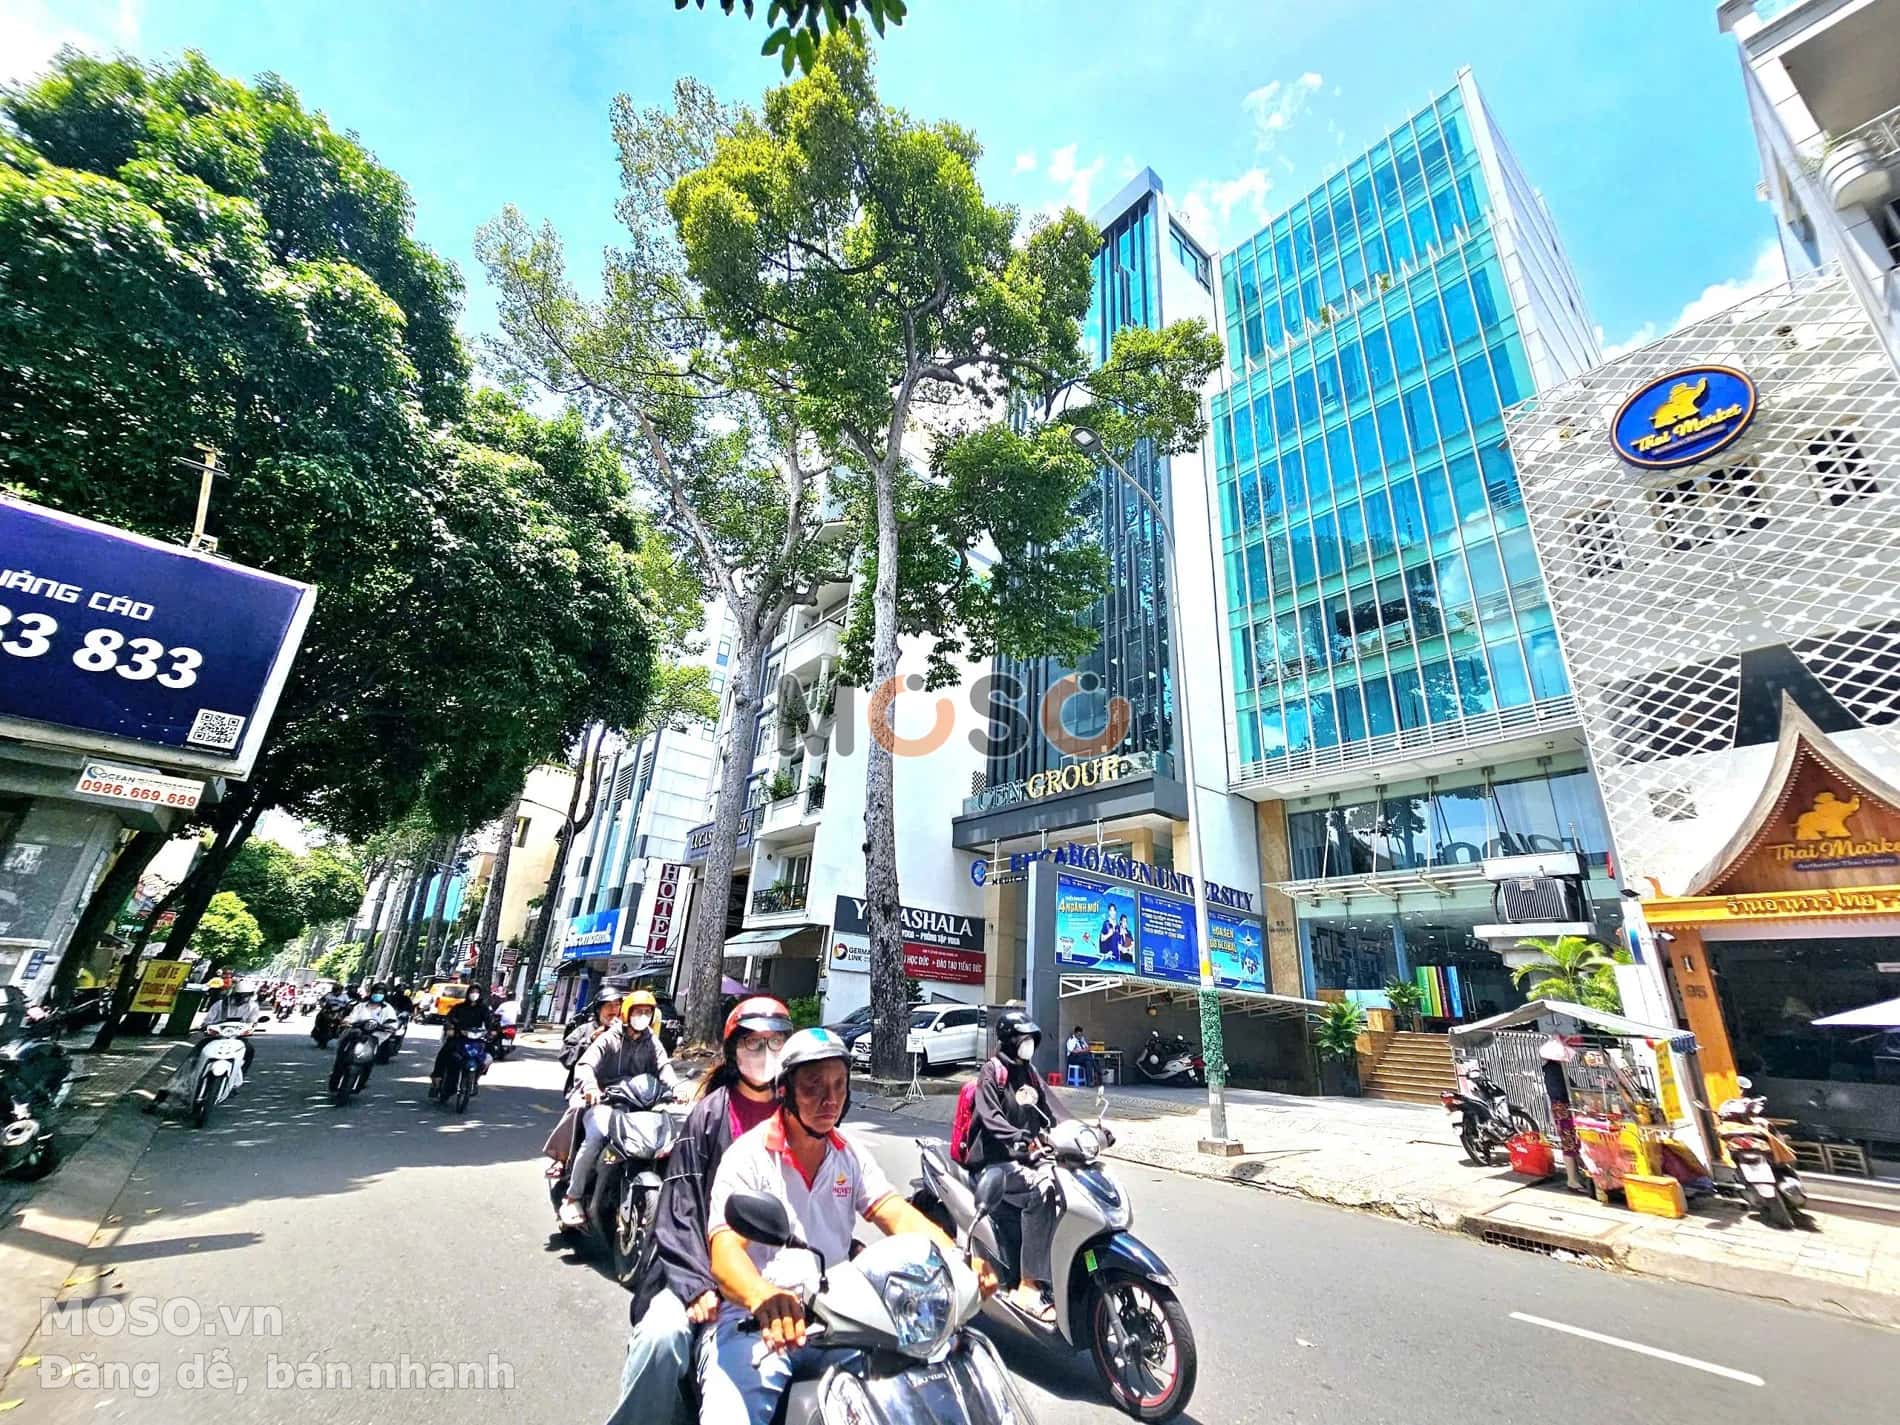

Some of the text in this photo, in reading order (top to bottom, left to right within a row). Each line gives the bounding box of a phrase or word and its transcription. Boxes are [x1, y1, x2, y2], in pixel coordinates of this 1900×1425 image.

[87, 592, 155, 621] CÁO
[72, 628, 203, 690] 833
[81, 779, 197, 807] 0986.669.689
[100, 772, 135, 783] OCEAN
[1026, 754, 1121, 800] GROUP
[1765, 843, 1819, 861] Thai
[1153, 865, 1254, 911] UNIVRSITY
[646, 864, 680, 954] HOTEL
